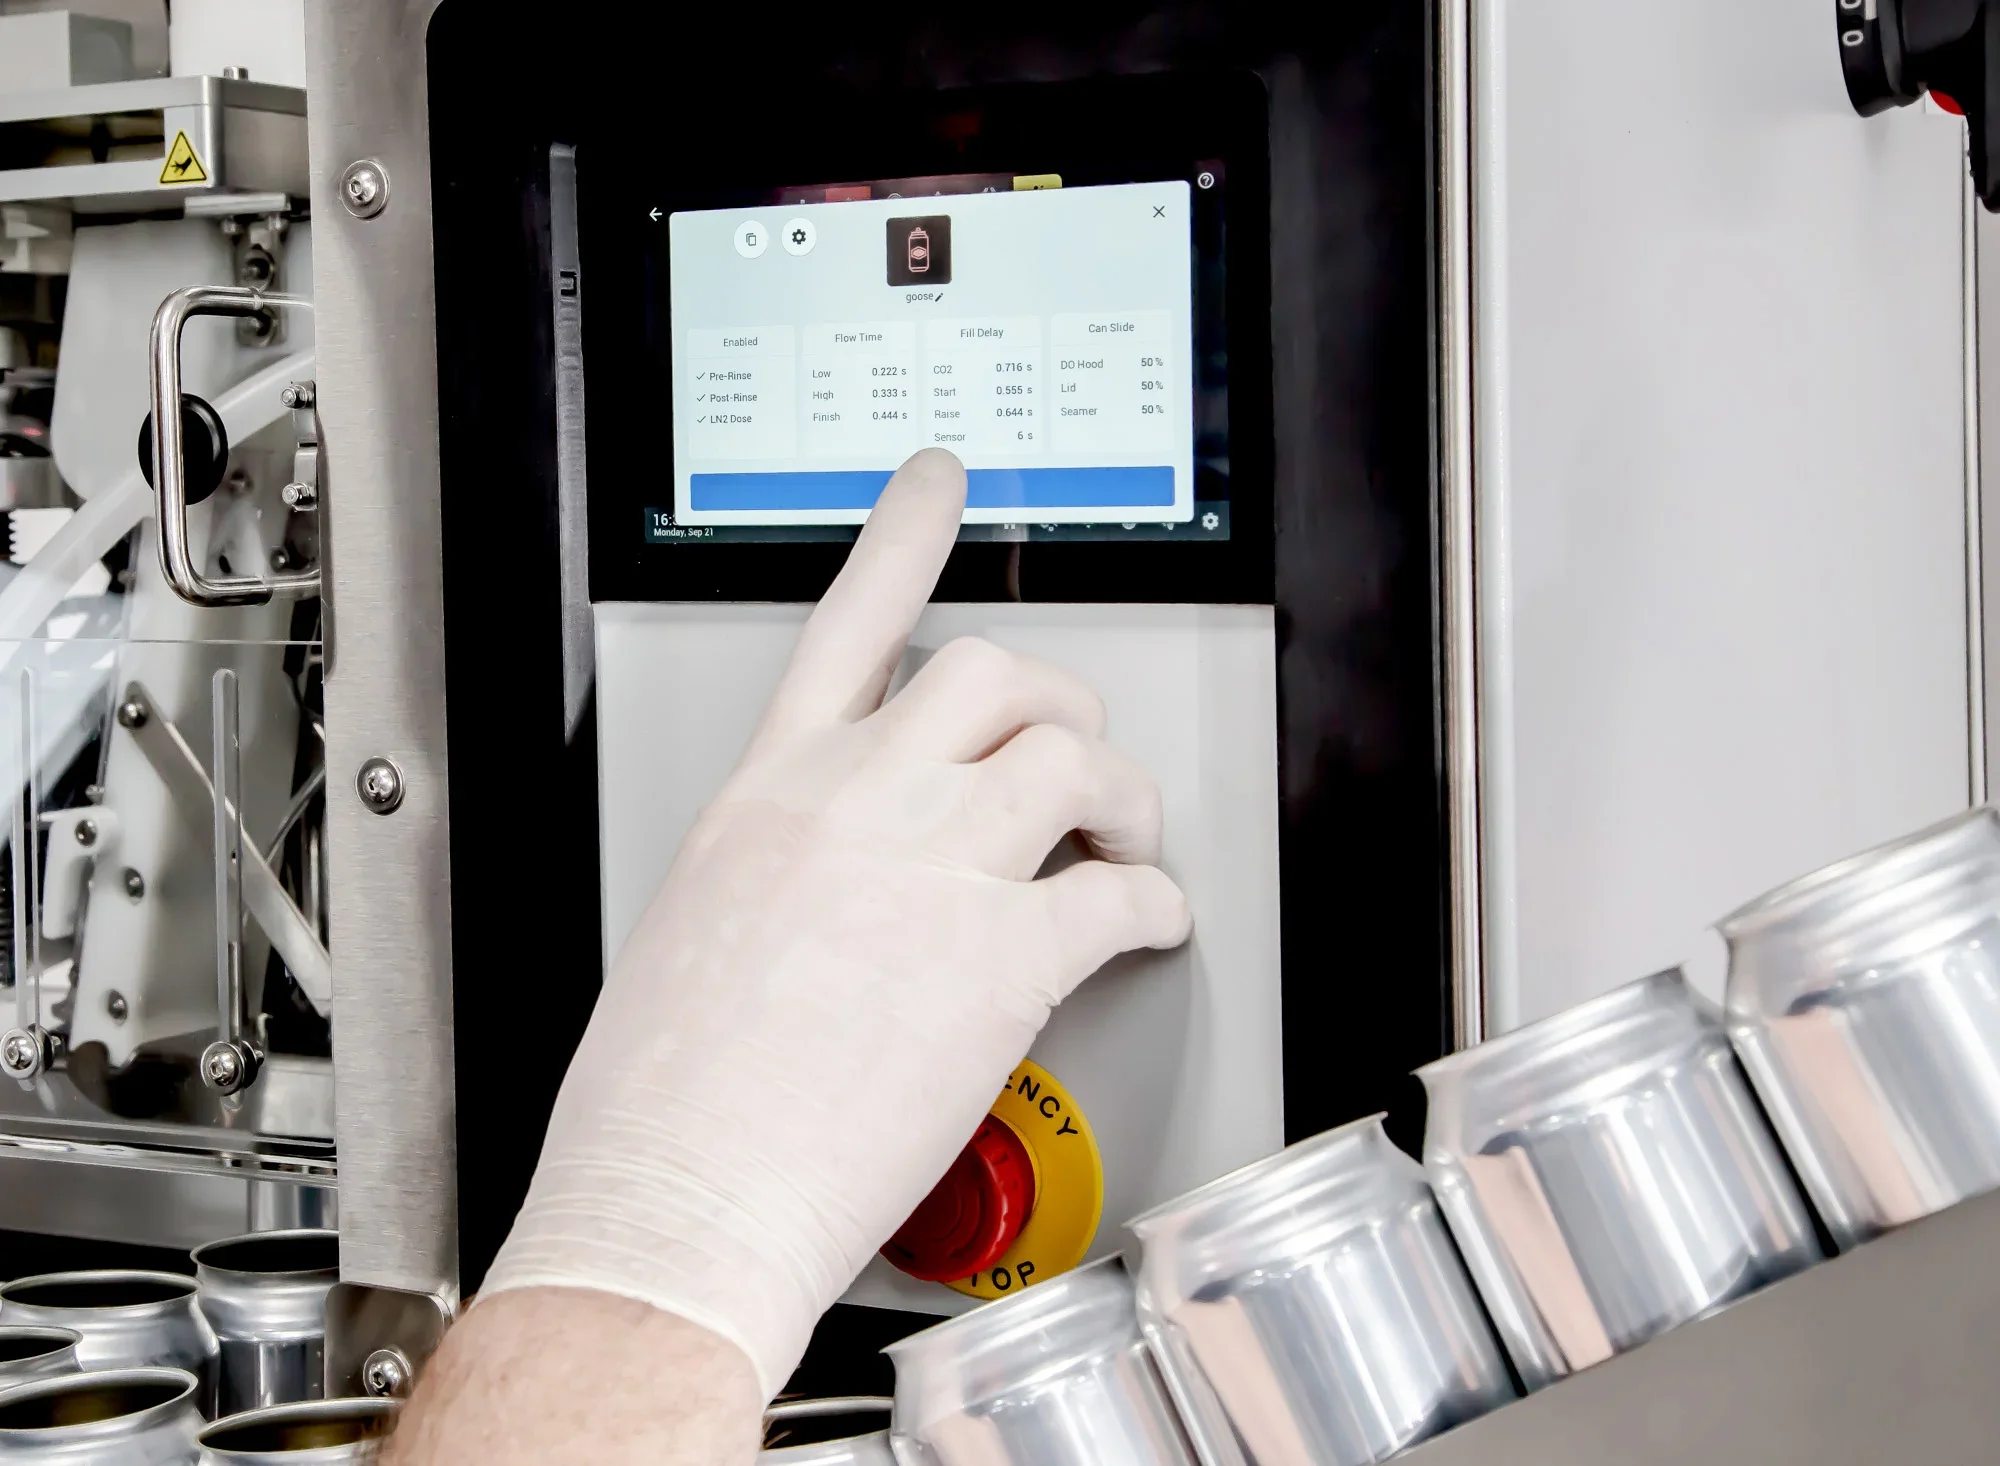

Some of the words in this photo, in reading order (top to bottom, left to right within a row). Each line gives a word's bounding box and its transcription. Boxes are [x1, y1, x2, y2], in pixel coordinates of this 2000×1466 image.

[905, 292, 934, 304] goose
[1088, 323, 1108, 333] Can
[1109, 321, 1135, 333] Slide
[835, 333, 857, 343] Flow
[858, 332, 883, 342] Time
[960, 328, 975, 338] Fill
[977, 327, 1004, 340] Delay
[723, 336, 758, 347] Enabled
[995, 362, 1023, 373] 0.716
[1077, 358, 1104, 369] Hood
[812, 369, 832, 379] Low
[871, 366, 898, 377] 0.222
[933, 364, 953, 375] CO2
[709, 370, 752, 381] Pre-Rinse
[872, 388, 898, 398] 0.333
[933, 387, 956, 397] Start
[996, 385, 1023, 396] 0.555
[1060, 382, 1077, 393] Lid
[709, 392, 758, 403] Post-Rinse
[812, 389, 834, 401] High
[813, 411, 841, 422] Finish
[872, 410, 899, 421] 0.444
[934, 408, 961, 419] Raise
[996, 407, 1024, 418] 0.644
[1060, 407, 1098, 417] Seamer
[710, 414, 729, 424] LN2
[730, 414, 753, 424] Dose
[934, 432, 966, 442] Sensor
[653, 513, 678, 526] 16:
[653, 528, 687, 538] Monday,
[688, 528, 703, 538] Sep
[704, 528, 714, 537] 21
